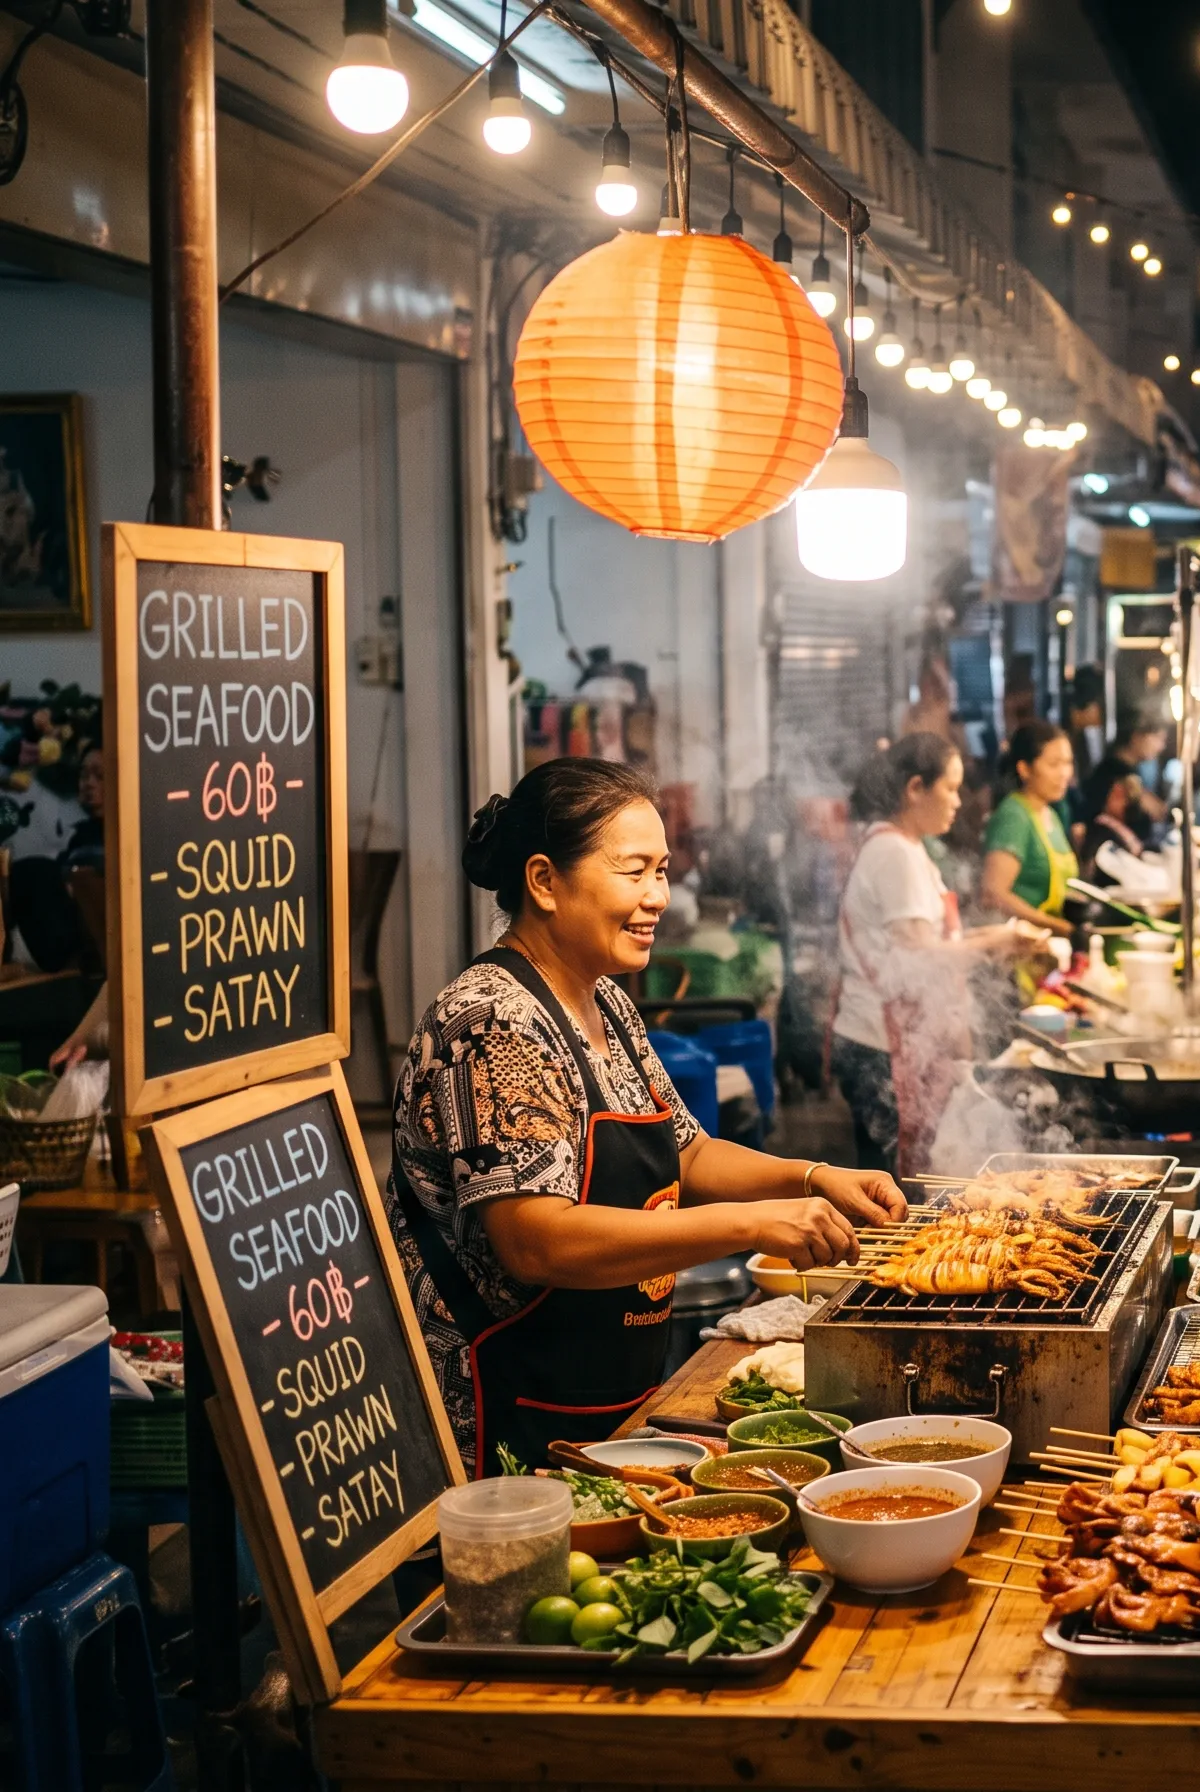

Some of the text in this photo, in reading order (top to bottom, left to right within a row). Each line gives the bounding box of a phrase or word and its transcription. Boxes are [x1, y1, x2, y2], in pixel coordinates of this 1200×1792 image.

[139, 589, 309, 662] GRILLED
[144, 681, 316, 754] SEAFOOD
[176, 833, 296, 901] SQUID
[179, 896, 306, 974] PRAWN
[183, 963, 302, 1043] SATAY
[191, 1121, 329, 1224] GRILLED
[228, 1188, 361, 1291] SEAFOOD
[275, 1335, 366, 1420] SQUID
[295, 1383, 398, 1487] PRAWN
[318, 1448, 405, 1549] SATAY
